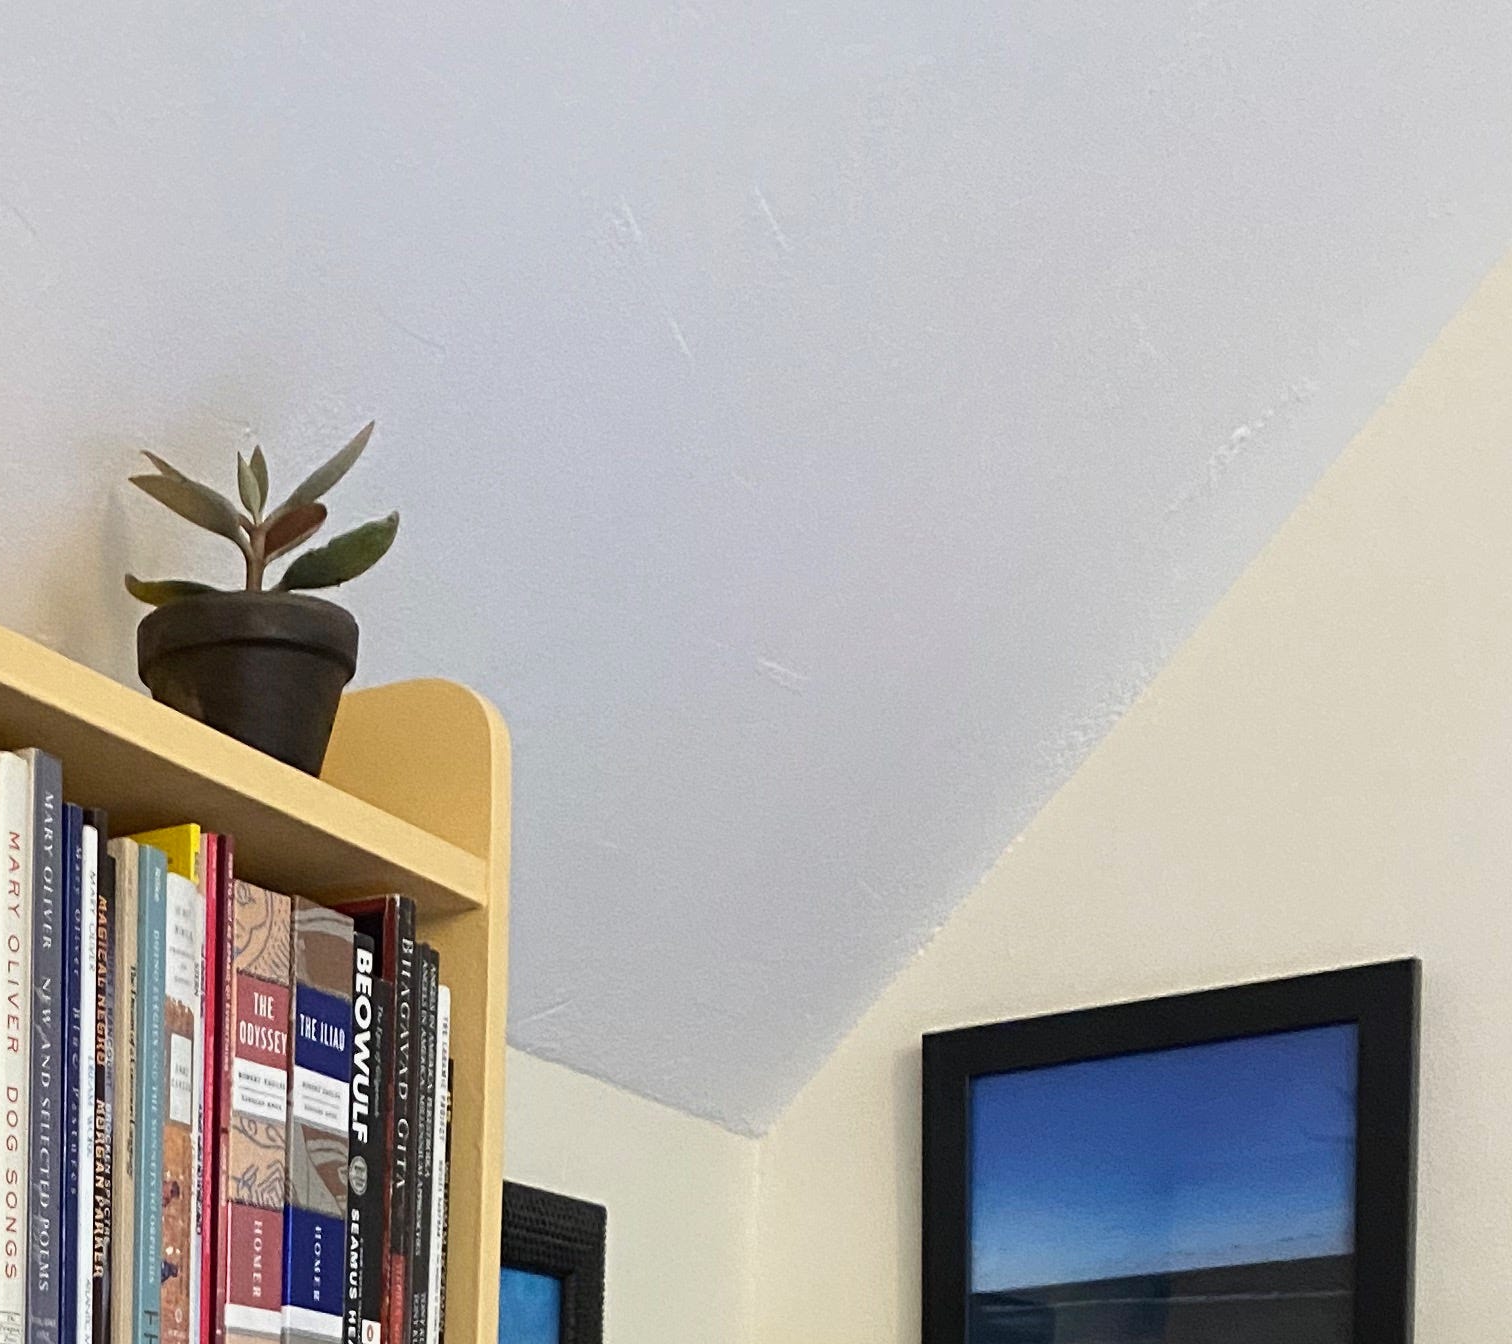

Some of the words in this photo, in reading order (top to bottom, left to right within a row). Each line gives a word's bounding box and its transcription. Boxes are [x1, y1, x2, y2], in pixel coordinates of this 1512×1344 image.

[43, 792, 55, 856] MARY
[8, 831, 21, 919] MARY
[42, 867, 54, 949] OLIVER
[152, 867, 161, 902] Rilke
[97, 896, 107, 986] MAGICAL
[7, 935, 21, 1054] OLIVER
[41, 976, 52, 1029] NEW
[96, 994, 107, 1065] NEGRO
[254, 992, 274, 1020] THE
[398, 937, 414, 1100] BHAGAVAD
[41, 1038, 52, 1087] AND
[240, 1020, 287, 1056] ODYSSEY
[300, 1014, 317, 1042] THE
[321, 1022, 345, 1051] ILIAD
[352, 948, 373, 1143] BEOWULF
[6, 1087, 18, 1152] DOG
[39, 1097, 49, 1208] SELECTED
[95, 1099, 106, 1186] MORGAN
[396, 1118, 409, 1188] GITA
[5, 1169, 18, 1280] SONGS
[38, 1218, 49, 1291] POEMS
[93, 1195, 105, 1277] PARKER
[253, 1220, 263, 1297] HOMER
[349, 1208, 360, 1299] SEAMUS
[314, 1227, 322, 1301] HOMER
